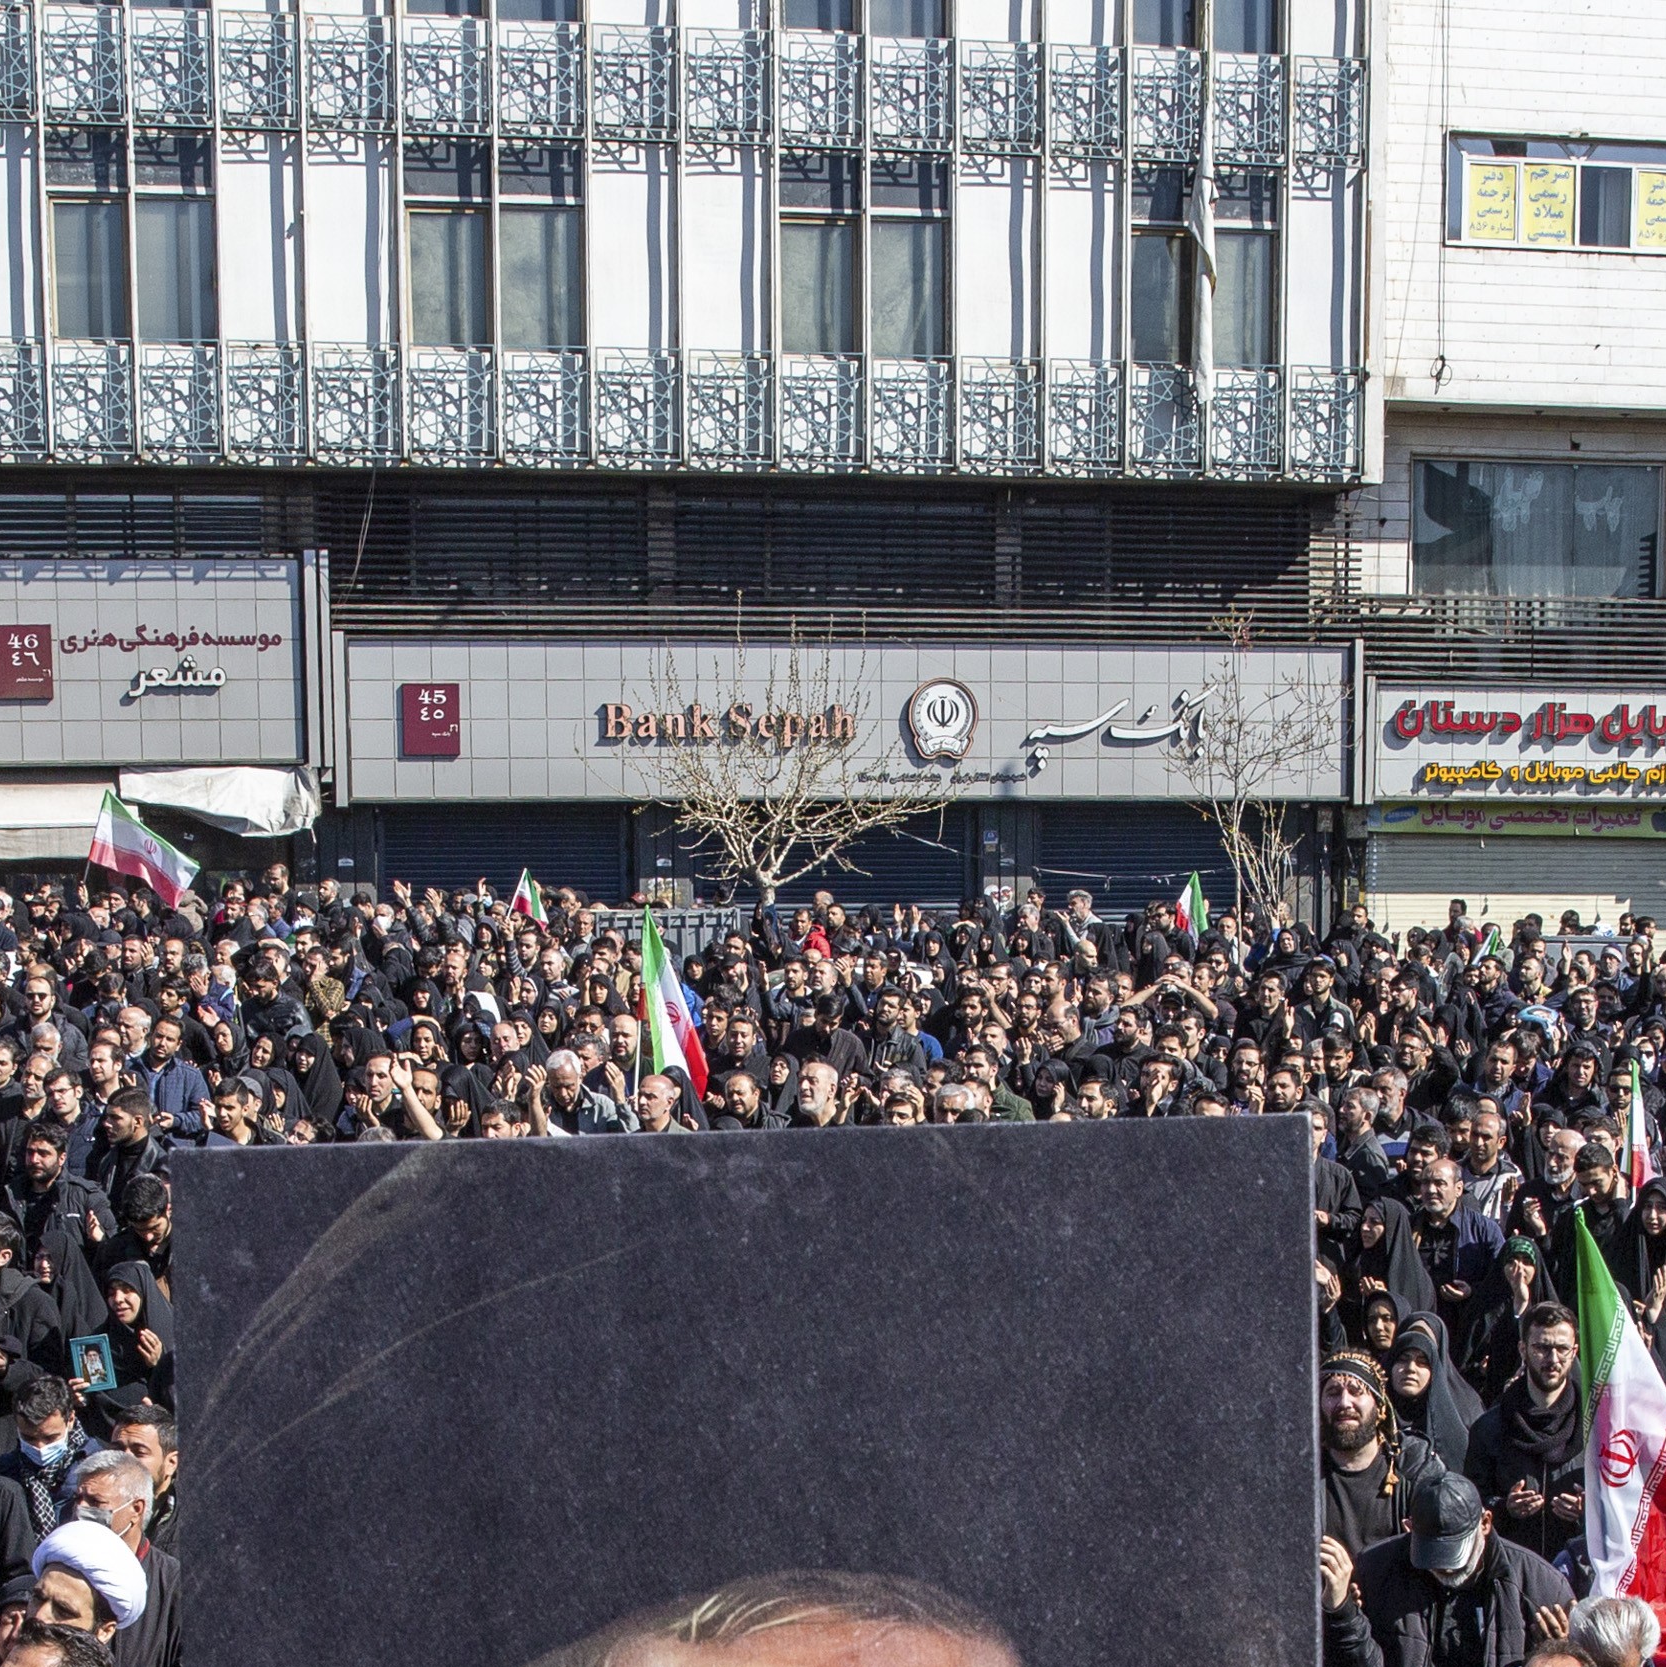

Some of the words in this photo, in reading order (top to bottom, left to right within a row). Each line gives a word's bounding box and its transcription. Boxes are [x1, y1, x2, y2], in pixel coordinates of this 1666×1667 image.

[1477, 186, 1511, 203] ترجمه
[1528, 189, 1567, 204] رسمی
[1477, 206, 1510, 219] رسمی
[1533, 204, 1565, 222] میلاد
[7, 633, 40, 649] 46
[59, 628, 118, 655] هنری
[118, 624, 200, 653] فرهنگی
[201, 634, 283, 652] موسسه
[128, 655, 227, 698] مشعر
[418, 689, 447, 705] 45
[603, 703, 717, 738] Bank
[728, 702, 856, 748] Sepah
[1109, 682, 1219, 758] بانک
[1395, 699, 1522, 740] دستان
[1531, 702, 1596, 741] هزار
[1028, 698, 1131, 770] سپه
[1423, 761, 1503, 785] کامپیوتر
[1510, 768, 1520, 783] و
[1523, 761, 1584, 785] موبایل
[1589, 762, 1641, 784] جانبی
[1420, 802, 1486, 831] موبایل
[1488, 805, 1569, 831] تخصصی
[1572, 804, 1642, 833] تعمیرات
